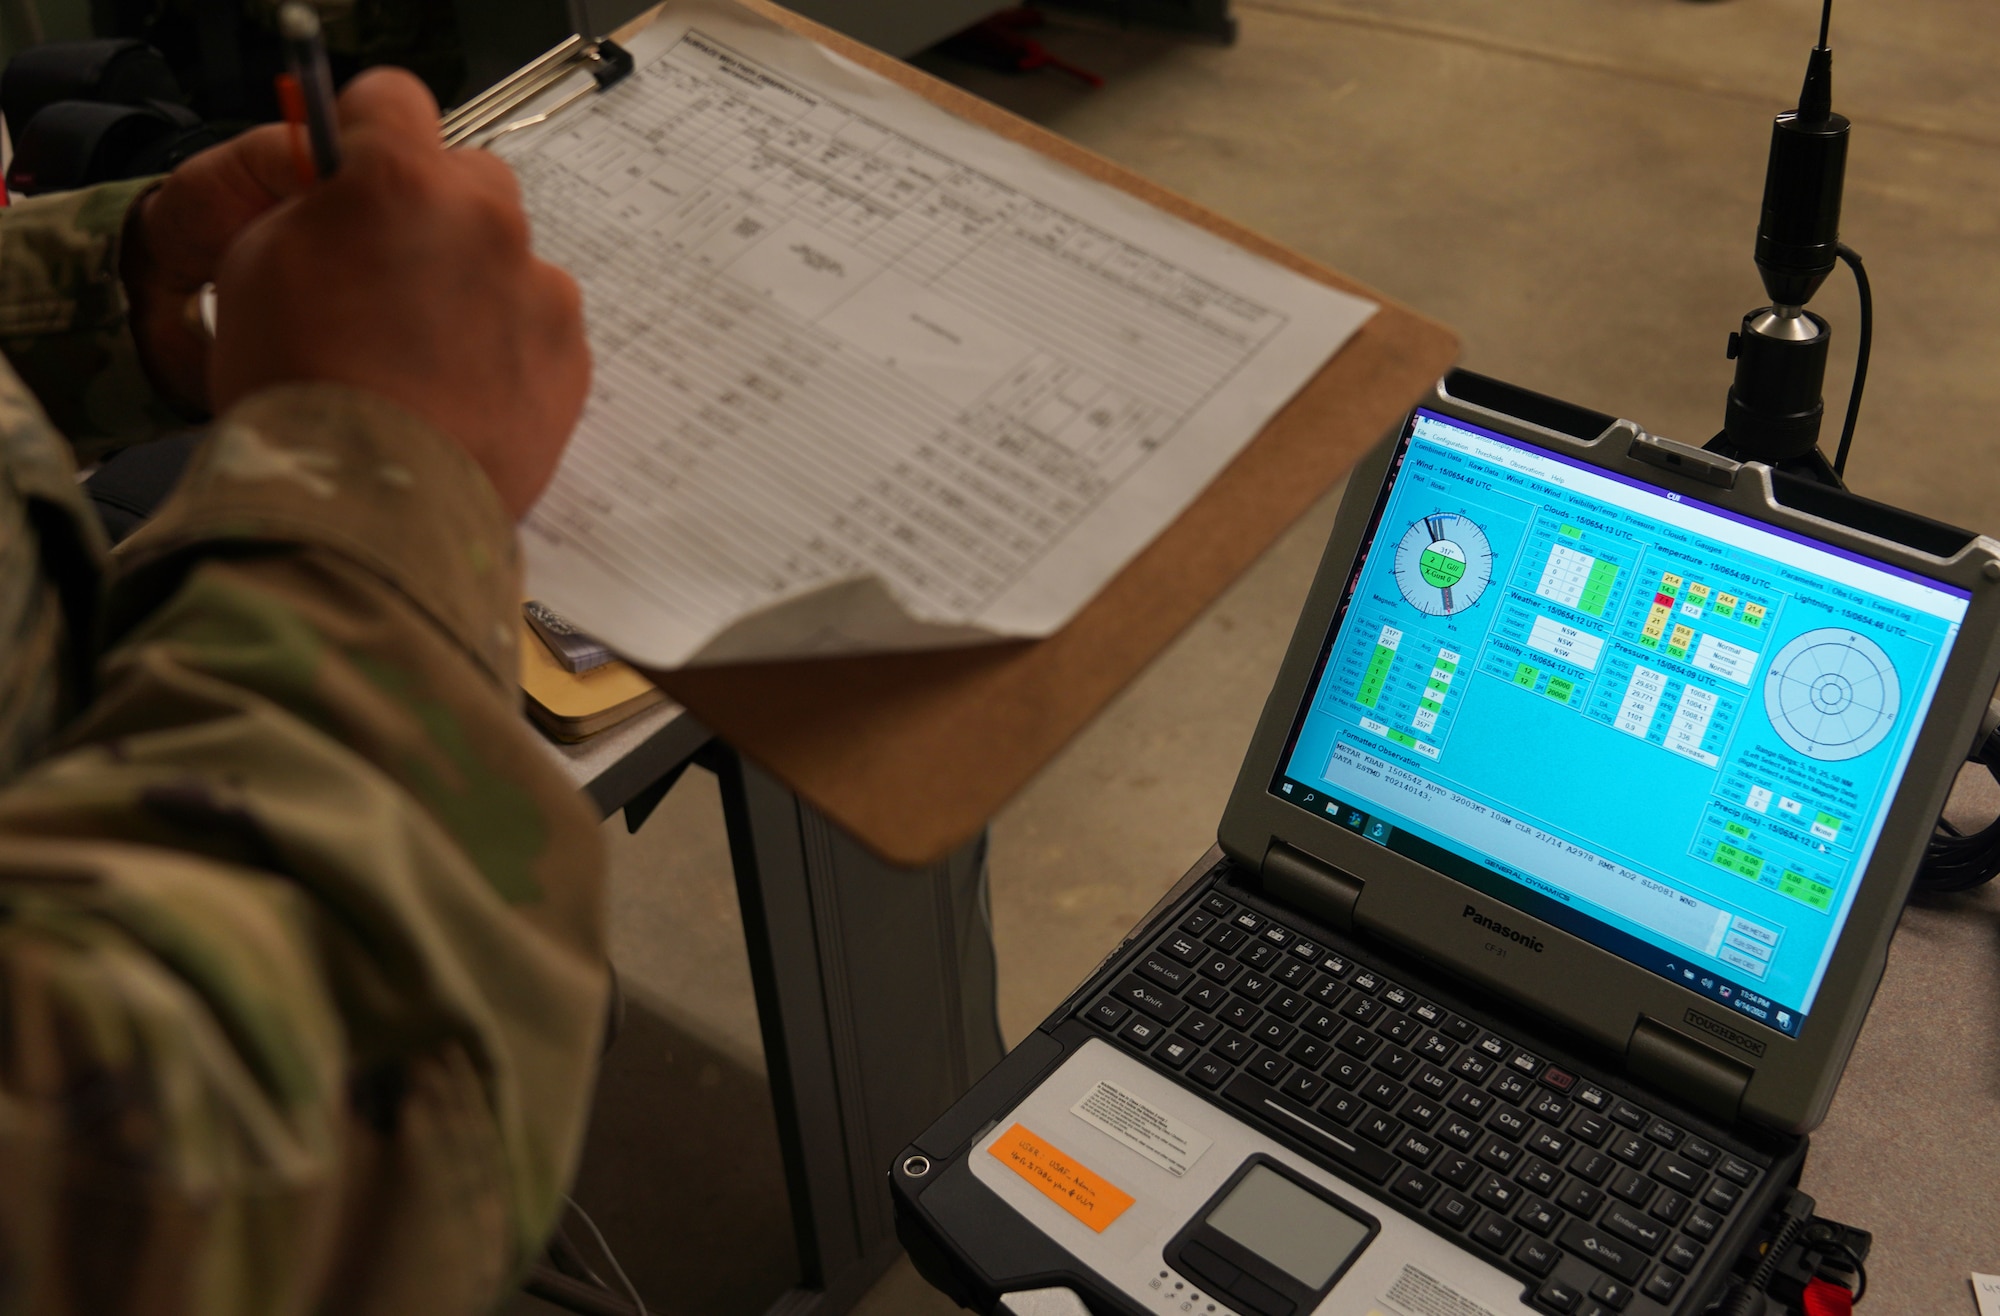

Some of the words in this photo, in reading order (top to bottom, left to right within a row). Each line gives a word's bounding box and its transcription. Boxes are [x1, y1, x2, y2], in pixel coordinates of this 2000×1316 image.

[1416, 428, 1427, 436] File
[1431, 433, 1469, 452] Configuration
[1474, 448, 1504, 463] Thresholds
[1508, 460, 1545, 477] Observations
[1550, 474, 1565, 485] Help
[1412, 474, 1425, 483] Plot
[1414, 459, 1434, 471] Wind
[1438, 467, 1474, 485] 15/0654:48
[1474, 479, 1492, 491] UTC
[1430, 481, 1446, 491] Rose
[1666, 491, 1681, 502] CUI
[1413, 441, 1446, 457] Combined
[1446, 453, 1462, 463] Data
[1468, 461, 1483, 471] Raw
[1483, 466, 1499, 476] Data
[1505, 474, 1523, 485] Wind
[1567, 495, 1618, 519] Visibility/Temp
[1624, 515, 1656, 531] Pressure
[1662, 528, 1688, 542] Clouds
[1693, 539, 1723, 555] Gauges
[1779, 569, 1825, 590] Parameters
[1831, 587, 1847, 598] Obs
[1846, 592, 1864, 605] Log
[1871, 601, 1894, 614] Event
[1894, 609, 1912, 621] Log
[1542, 503, 1570, 518] Clouds
[1574, 515, 1614, 534] 15/0654:13
[1614, 528, 1633, 540] UTC
[1439, 546, 1454, 557] 317°
[1598, 551, 1618, 563] Height
[1652, 542, 1703, 566] Temperature
[1709, 562, 1751, 582] 15/0654:09
[1750, 576, 1770, 589] UTC
[1424, 568, 1446, 581] X-Gust
[1372, 594, 1398, 608] Magnetic
[1661, 585, 1675, 594] 14.3
[1687, 595, 1703, 604] 57.7
[1715, 605, 1730, 614] 15.5
[1743, 615, 1757, 624] 14.1
[1664, 575, 1679, 584] 21.4
[1692, 584, 1707, 594] 70.5
[1718, 594, 1734, 604] 24.4
[1747, 604, 1762, 614] 21.4
[1508, 607, 1529, 619] Present
[1560, 627, 1577, 637] NSW
[1509, 591, 1541, 608] Weather
[1546, 605, 1585, 625] 15/0654:12
[1584, 619, 1604, 632] UTC
[1684, 605, 1699, 615] 12.8
[1792, 592, 1834, 613] Lightning
[1840, 608, 1885, 630] 15/0654:46
[1884, 624, 1906, 637] UTC
[1380, 637, 1395, 647] 297°
[1384, 627, 1399, 638] 317°
[1441, 651, 1456, 661] 335°
[1502, 627, 1521, 638] Recent
[1553, 647, 1569, 657] NSW
[1505, 617, 1525, 629] Instant
[1557, 636, 1573, 647] NSW
[1645, 627, 1659, 636] 19.2
[1712, 651, 1737, 665] Normal
[1675, 626, 1690, 635] 69.8
[1716, 641, 1741, 655] Normal
[1491, 638, 1523, 657] Visibility
[1527, 652, 1566, 672] 15/0654:12
[1566, 667, 1585, 680] UTC
[1613, 642, 1650, 662] Pressure
[1655, 658, 1697, 679] 15/0654:09
[1696, 673, 1716, 687] UTC
[1640, 637, 1655, 646] 21.4
[1667, 647, 1682, 657] 70.5
[1708, 662, 1733, 676] Normal
[1434, 670, 1448, 681] 314°
[1519, 677, 1528, 685] 12
[1546, 688, 1567, 700] 20000
[1550, 678, 1571, 690] 20000
[1640, 670, 1659, 681] 29.78
[1689, 688, 1711, 701] 1008.5
[1631, 689, 1653, 702] 29.771
[1681, 709, 1703, 722] 1008.1
[1631, 701, 1644, 711] 248
[1635, 679, 1657, 692] 29.653
[1685, 699, 1707, 712] 1004.1
[1415, 720, 1430, 730] 357°
[1419, 710, 1433, 720] 317°
[1626, 711, 1642, 722] 1101
[1677, 732, 1690, 741] 336
[1341, 728, 1377, 749] Formatted
[1377, 745, 1420, 768] Observation
[1367, 721, 1381, 731] 333°
[1417, 743, 1435, 755] 06:45
[1624, 722, 1635, 731] 0.9
[1675, 743, 1705, 760] Increase
[1332, 752, 1353, 766] DATA
[1355, 762, 1381, 778] ESTMD
[1383, 775, 1433, 802] T02140143;
[1335, 743, 1361, 759] METAR
[1363, 755, 1384, 769] KBAB
[1387, 765, 1422, 786] 150654Z
[1425, 782, 1447, 797] AUTO
[1449, 793, 1486, 814] 32003KT
[1489, 810, 1512, 826] 10SM
[1514, 822, 1532, 835] CLR
[1534, 831, 1562, 849] 21/14
[1565, 844, 1594, 863] A2978
[1597, 858, 1616, 872] RMK
[1640, 877, 1675, 898] SLP081
[1678, 895, 1697, 909] WND
[1712, 800, 1741, 819] Precip
[1810, 841, 1831, 855] UC
[1728, 824, 1744, 835] 0.00
[1814, 825, 1832, 837] None
[1483, 858, 1523, 880] GENERAL
[1524, 877, 1570, 902] DYNAMICS
[1716, 856, 1732, 867] 0.00
[1738, 865, 1755, 877] 0.00
[1720, 845, 1736, 856] 0.00
[1743, 854, 1759, 866] 0.00
[1809, 883, 1826, 895] 0.00
[1211, 898, 1223, 909] Esc
[1462, 905, 1544, 954] Panasonic
[1749, 927, 1770, 941] METAR
[1484, 941, 1507, 958] CF-31
[1148, 960, 1164, 972] Caps
[1164, 970, 1180, 981] Lock
[1100, 1006, 1114, 1017] Ctrl
[1144, 994, 1162, 1008] Shift
[1739, 989, 1757, 1002] 11:54
[1756, 997, 1770, 1009] PM
[1688, 1012, 1763, 1054] TOUGHBOOK
[1204, 1064, 1217, 1074] Alt
[1408, 1178, 1424, 1190] Alt
[1613, 1213, 1638, 1230] Enter
[1598, 1246, 1622, 1262] Shift
